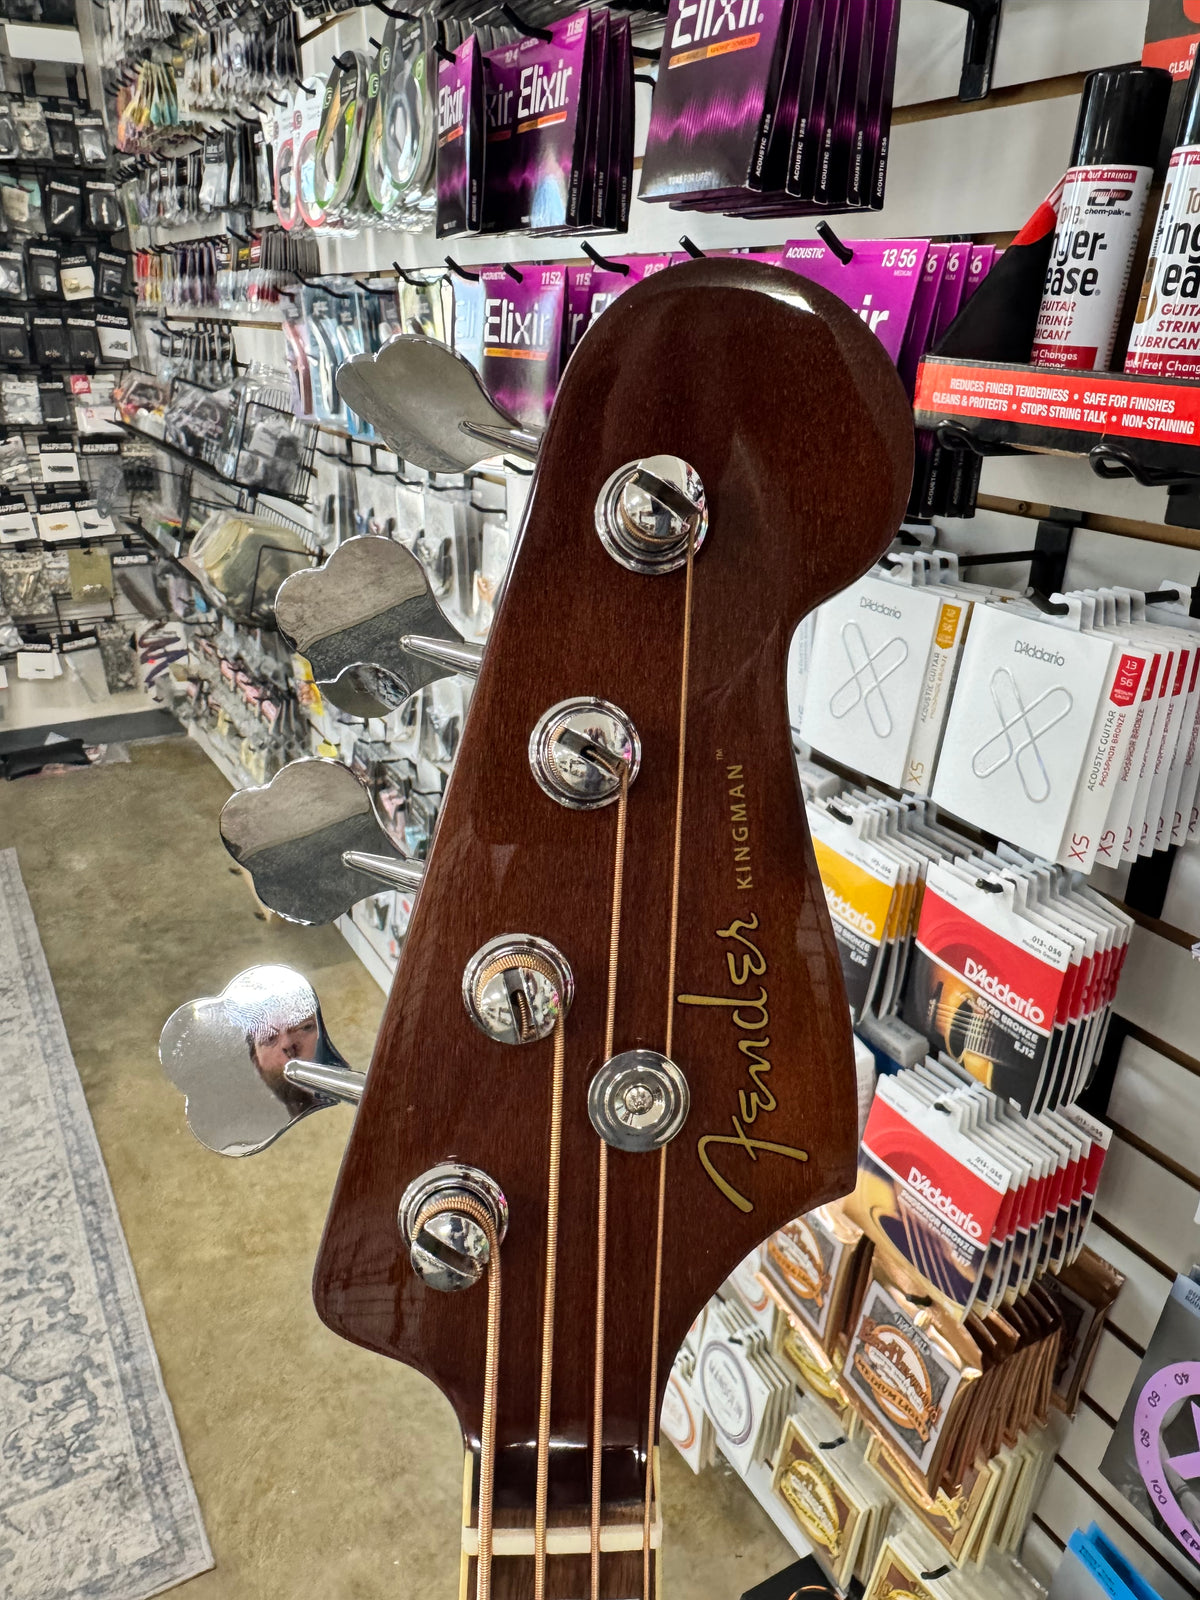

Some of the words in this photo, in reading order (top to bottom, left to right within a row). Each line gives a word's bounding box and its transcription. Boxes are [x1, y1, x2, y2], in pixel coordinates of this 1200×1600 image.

[517, 58, 573, 118] Elixir
[438, 79, 466, 132] Elixir
[755, 137, 767, 177] ACOUSTIC
[793, 142, 804, 181] ACOUSTIC
[821, 152, 830, 190] ACOUSTIC
[853, 154, 861, 192] ACOUSTIC
[876, 160, 885, 197] ACOUSTIC
[786, 247, 825, 259] ACOUSTIC
[1041, 300, 1077, 312] GUITAR
[484, 299, 551, 345] Elixir
[1156, 320, 1200, 334] STRIN
[1039, 349, 1078, 361] Changes
[1134, 336, 1200, 350] LUBRICAN
[1142, 359, 1163, 370] Fret
[950, 378, 985, 392] REDUCES
[985, 381, 1014, 396] FINGER
[1015, 384, 1069, 402] TENDERNESS
[1083, 391, 1108, 406] SAFE
[1108, 394, 1128, 408] FOR
[1129, 396, 1176, 413] FINISHES
[932, 391, 961, 406] CLEANS
[961, 395, 968, 406] &
[968, 396, 1008, 412] PROTECTS
[1020, 402, 1048, 416] STOPS
[1048, 405, 1081, 421] STRING
[1083, 409, 1108, 424] TALK
[1121, 413, 1195, 434] NON-STAINING
[860, 596, 902, 619] D'Addario
[1014, 639, 1065, 666] D'Addario
[1125, 660, 1138, 670] 13
[920, 683, 935, 723] ACOUSTIC
[930, 652, 940, 683] GUITAR
[1120, 677, 1133, 687] 56
[1087, 747, 1106, 792] ACOUSTIC
[1100, 710, 1117, 745] GUITAR
[1099, 746, 1116, 787] PHOSPHOR
[1111, 713, 1126, 745] BRONZE
[907, 760, 925, 785] XS
[726, 764, 753, 889] KINGMAN
[1068, 833, 1090, 863] XS
[1097, 830, 1116, 857] XS
[963, 957, 1045, 1024] D'Addario
[1000, 1014, 1039, 1043] BRONZE
[676, 912, 809, 1214] Fender
[1013, 1040, 1035, 1060] EJ12
[907, 1166, 983, 1238] D'Addario
[940, 1223, 976, 1255] BRONZE
[1174, 1372, 1190, 1386] 40
[1148, 1390, 1161, 1408] 60
[1140, 1428, 1151, 1448] 80
[1150, 1479, 1168, 1505] 100
